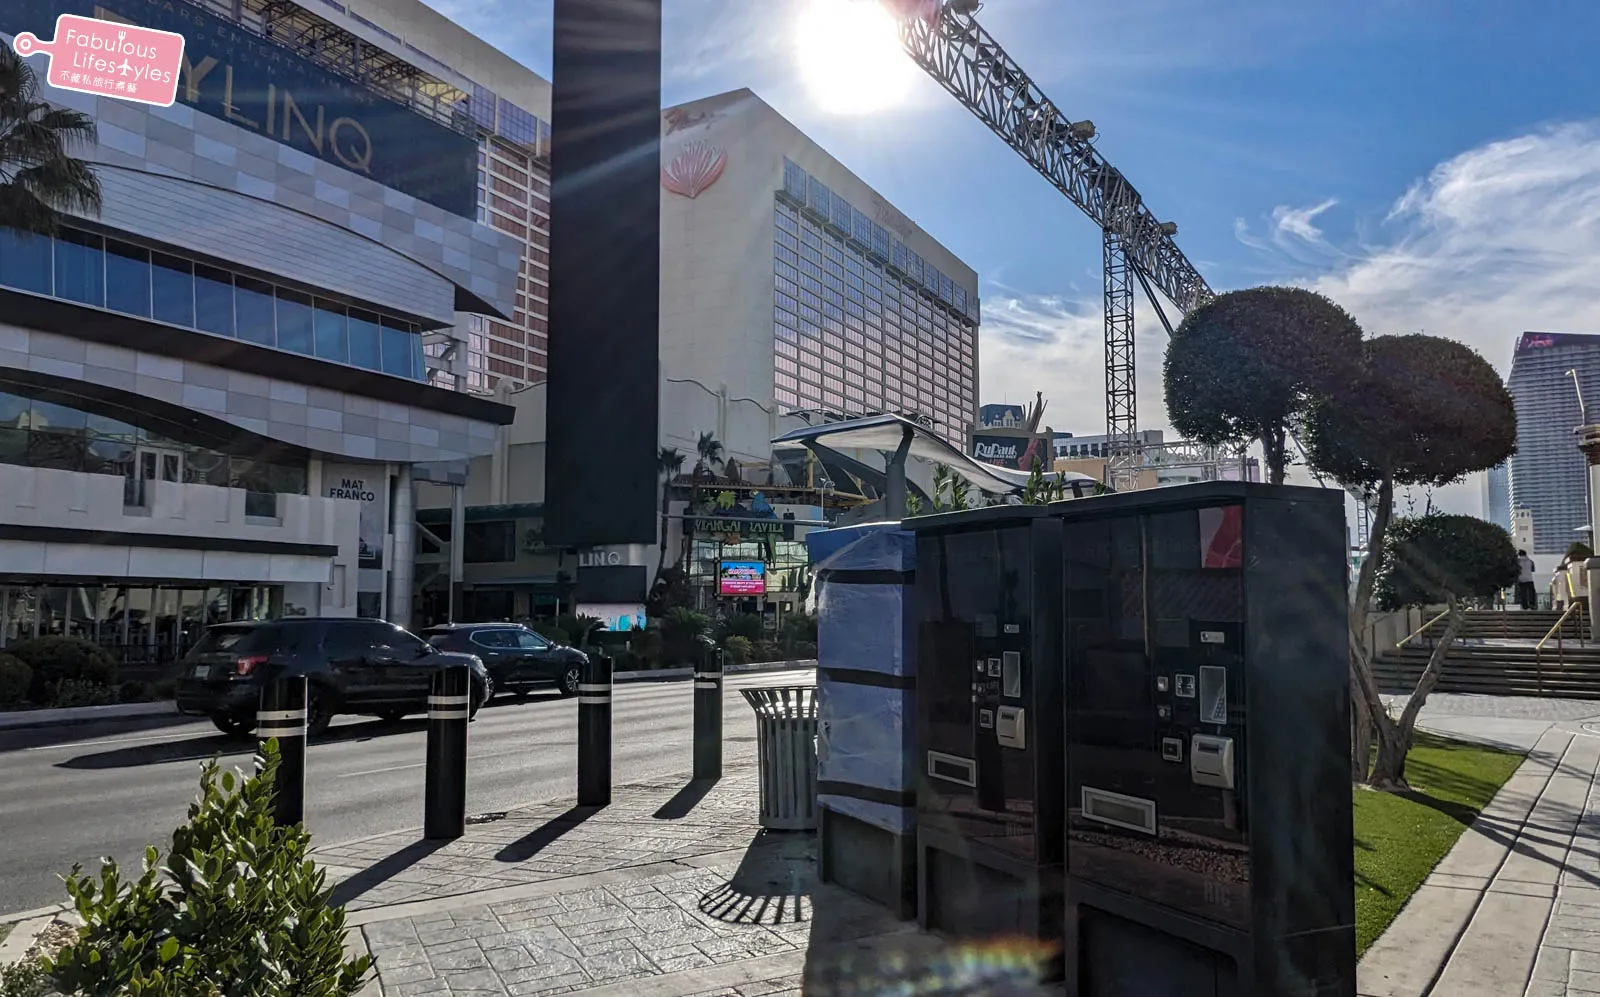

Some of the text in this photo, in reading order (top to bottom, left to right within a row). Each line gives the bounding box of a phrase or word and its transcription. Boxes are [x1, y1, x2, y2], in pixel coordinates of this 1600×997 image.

[224, 65, 373, 174] LINQ
[341, 478, 364, 490] MAT
[329, 487, 375, 502] FRANCO
[579, 551, 621, 567] LINQ
